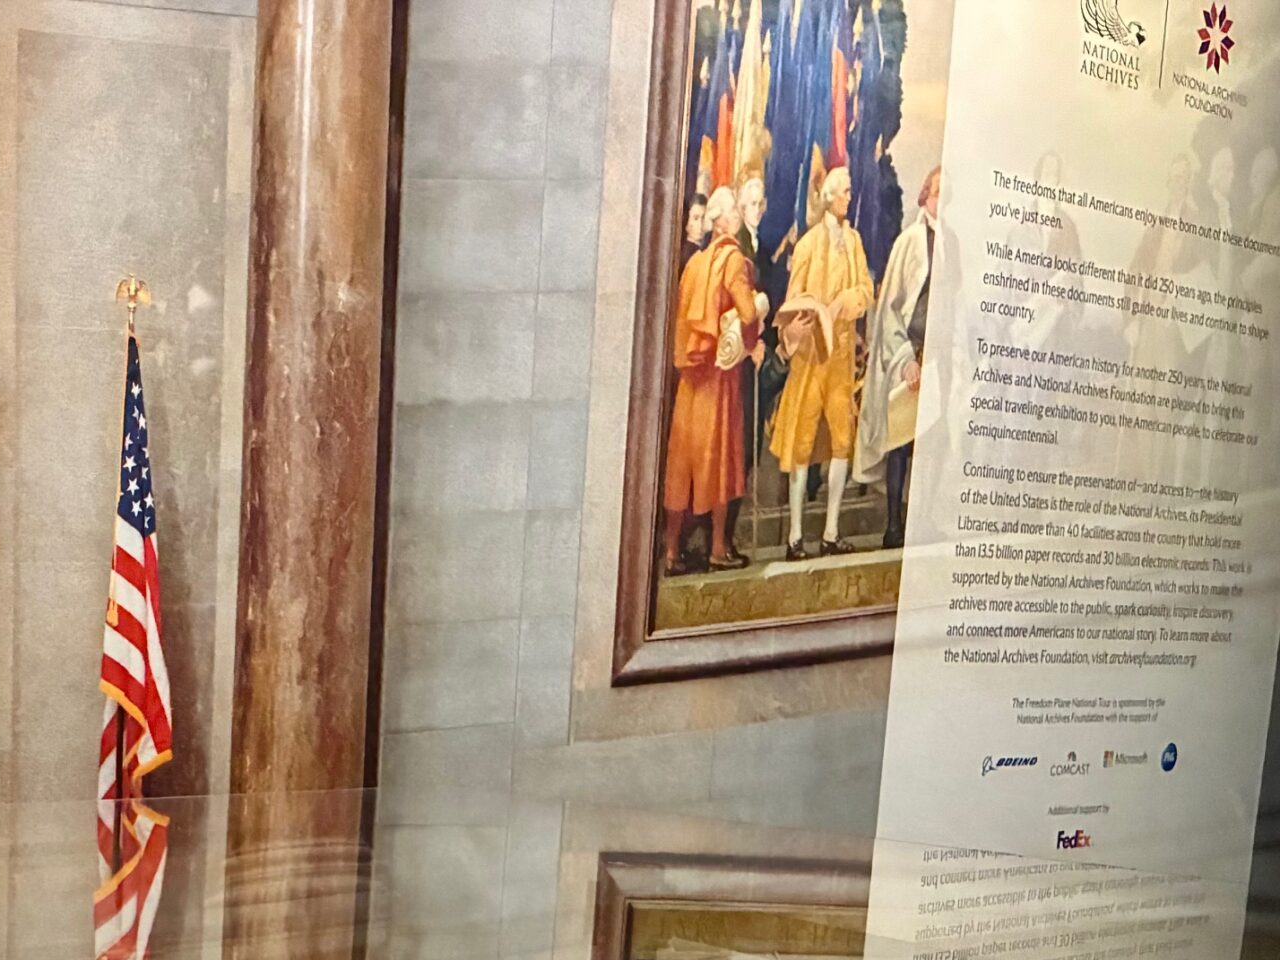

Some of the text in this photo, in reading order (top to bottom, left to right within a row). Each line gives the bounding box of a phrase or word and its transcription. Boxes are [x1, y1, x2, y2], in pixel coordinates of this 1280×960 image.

[1082, 40, 1141, 72] NATIONAL
[1080, 61, 1140, 91] ARCHIVES
[1173, 71, 1210, 96] NATIONAL
[1184, 94, 1233, 120] FOUNDATION
[989, 202, 1063, 229] you've just seen.
[980, 300, 1034, 323] our country.
[972, 366, 1012, 385] Archives
[1014, 373, 1032, 388] and
[1033, 374, 1071, 393] National
[1071, 381, 1108, 399] Archives
[1109, 386, 1156, 405] Foundation
[1156, 396, 1170, 408] are
[1170, 397, 1201, 413] pleased
[1211, 402, 1230, 420] bring
[943, 649, 959, 662] the
[960, 649, 1000, 663] National
[1000, 650, 1038, 663] Archives
[1040, 650, 1089, 664] Foundation,
[1091, 651, 1108, 664] visit
[1050, 763, 1090, 777] COMCAST
[1056, 829, 1092, 850] FedEx
